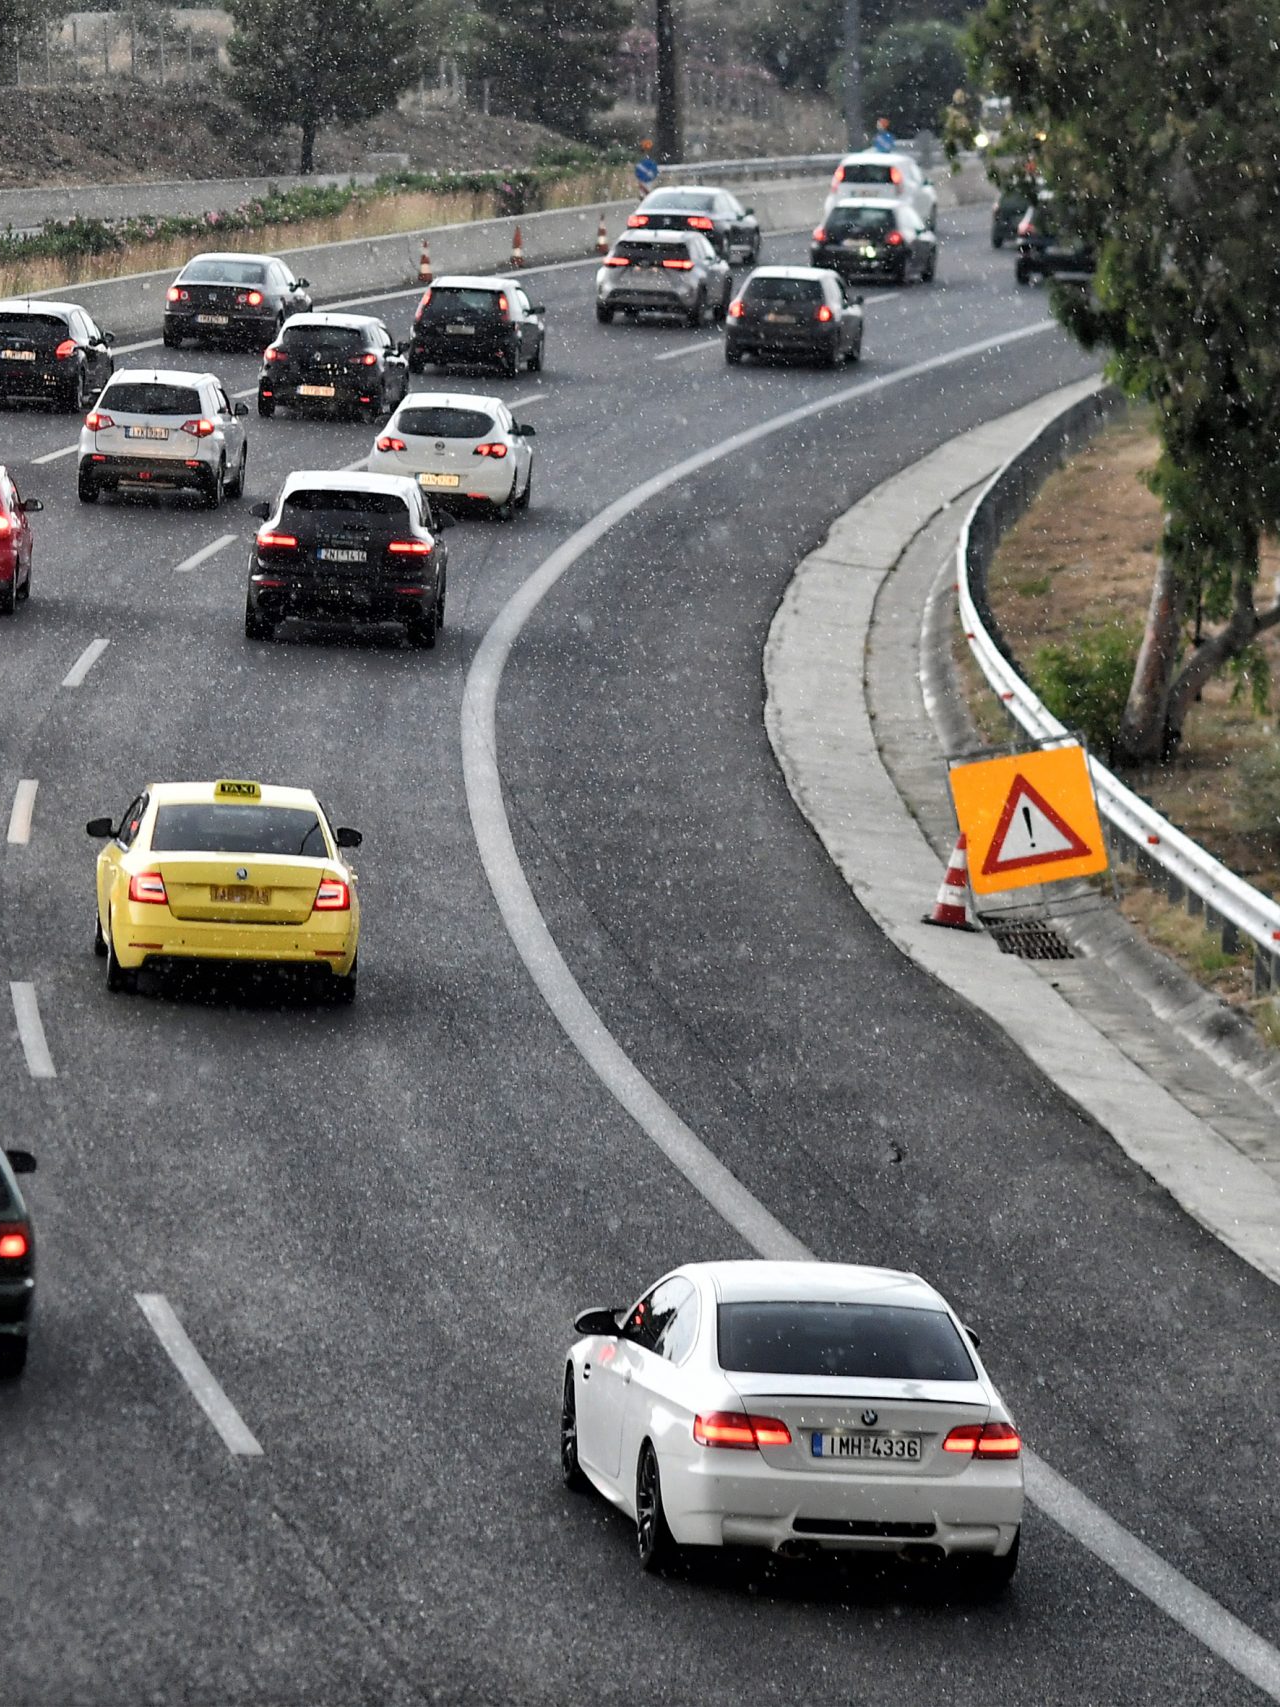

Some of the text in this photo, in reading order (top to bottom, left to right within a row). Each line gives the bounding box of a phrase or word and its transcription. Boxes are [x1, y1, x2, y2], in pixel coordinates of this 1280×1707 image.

[223, 784, 254, 794] TAXI
[831, 1436, 918, 1458] IMH 4336
